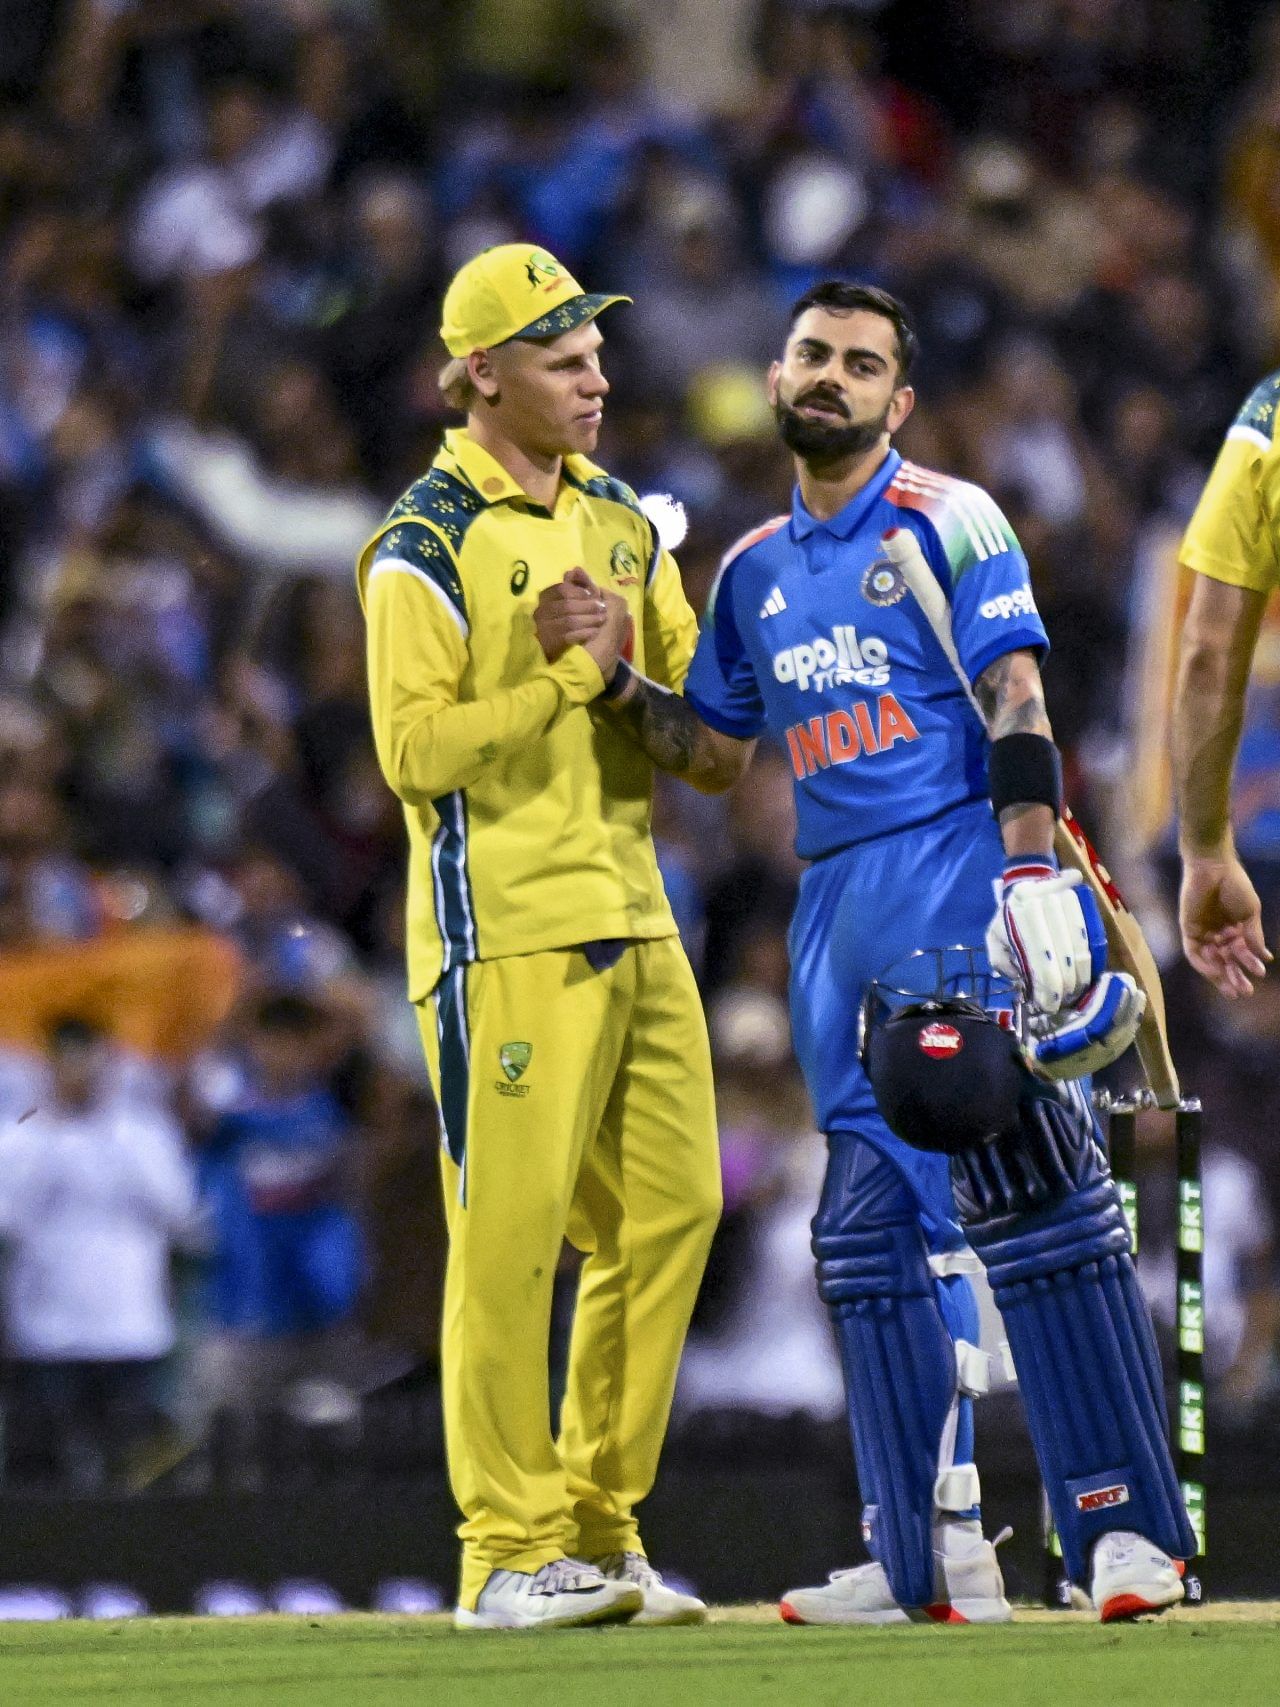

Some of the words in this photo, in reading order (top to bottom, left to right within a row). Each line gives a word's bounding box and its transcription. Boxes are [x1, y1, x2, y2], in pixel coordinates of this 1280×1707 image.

[773, 625, 888, 691] apollo
[812, 665, 891, 693] TYRES
[785, 692, 922, 781] INDIA
[1184, 1483, 1205, 1555] KT
